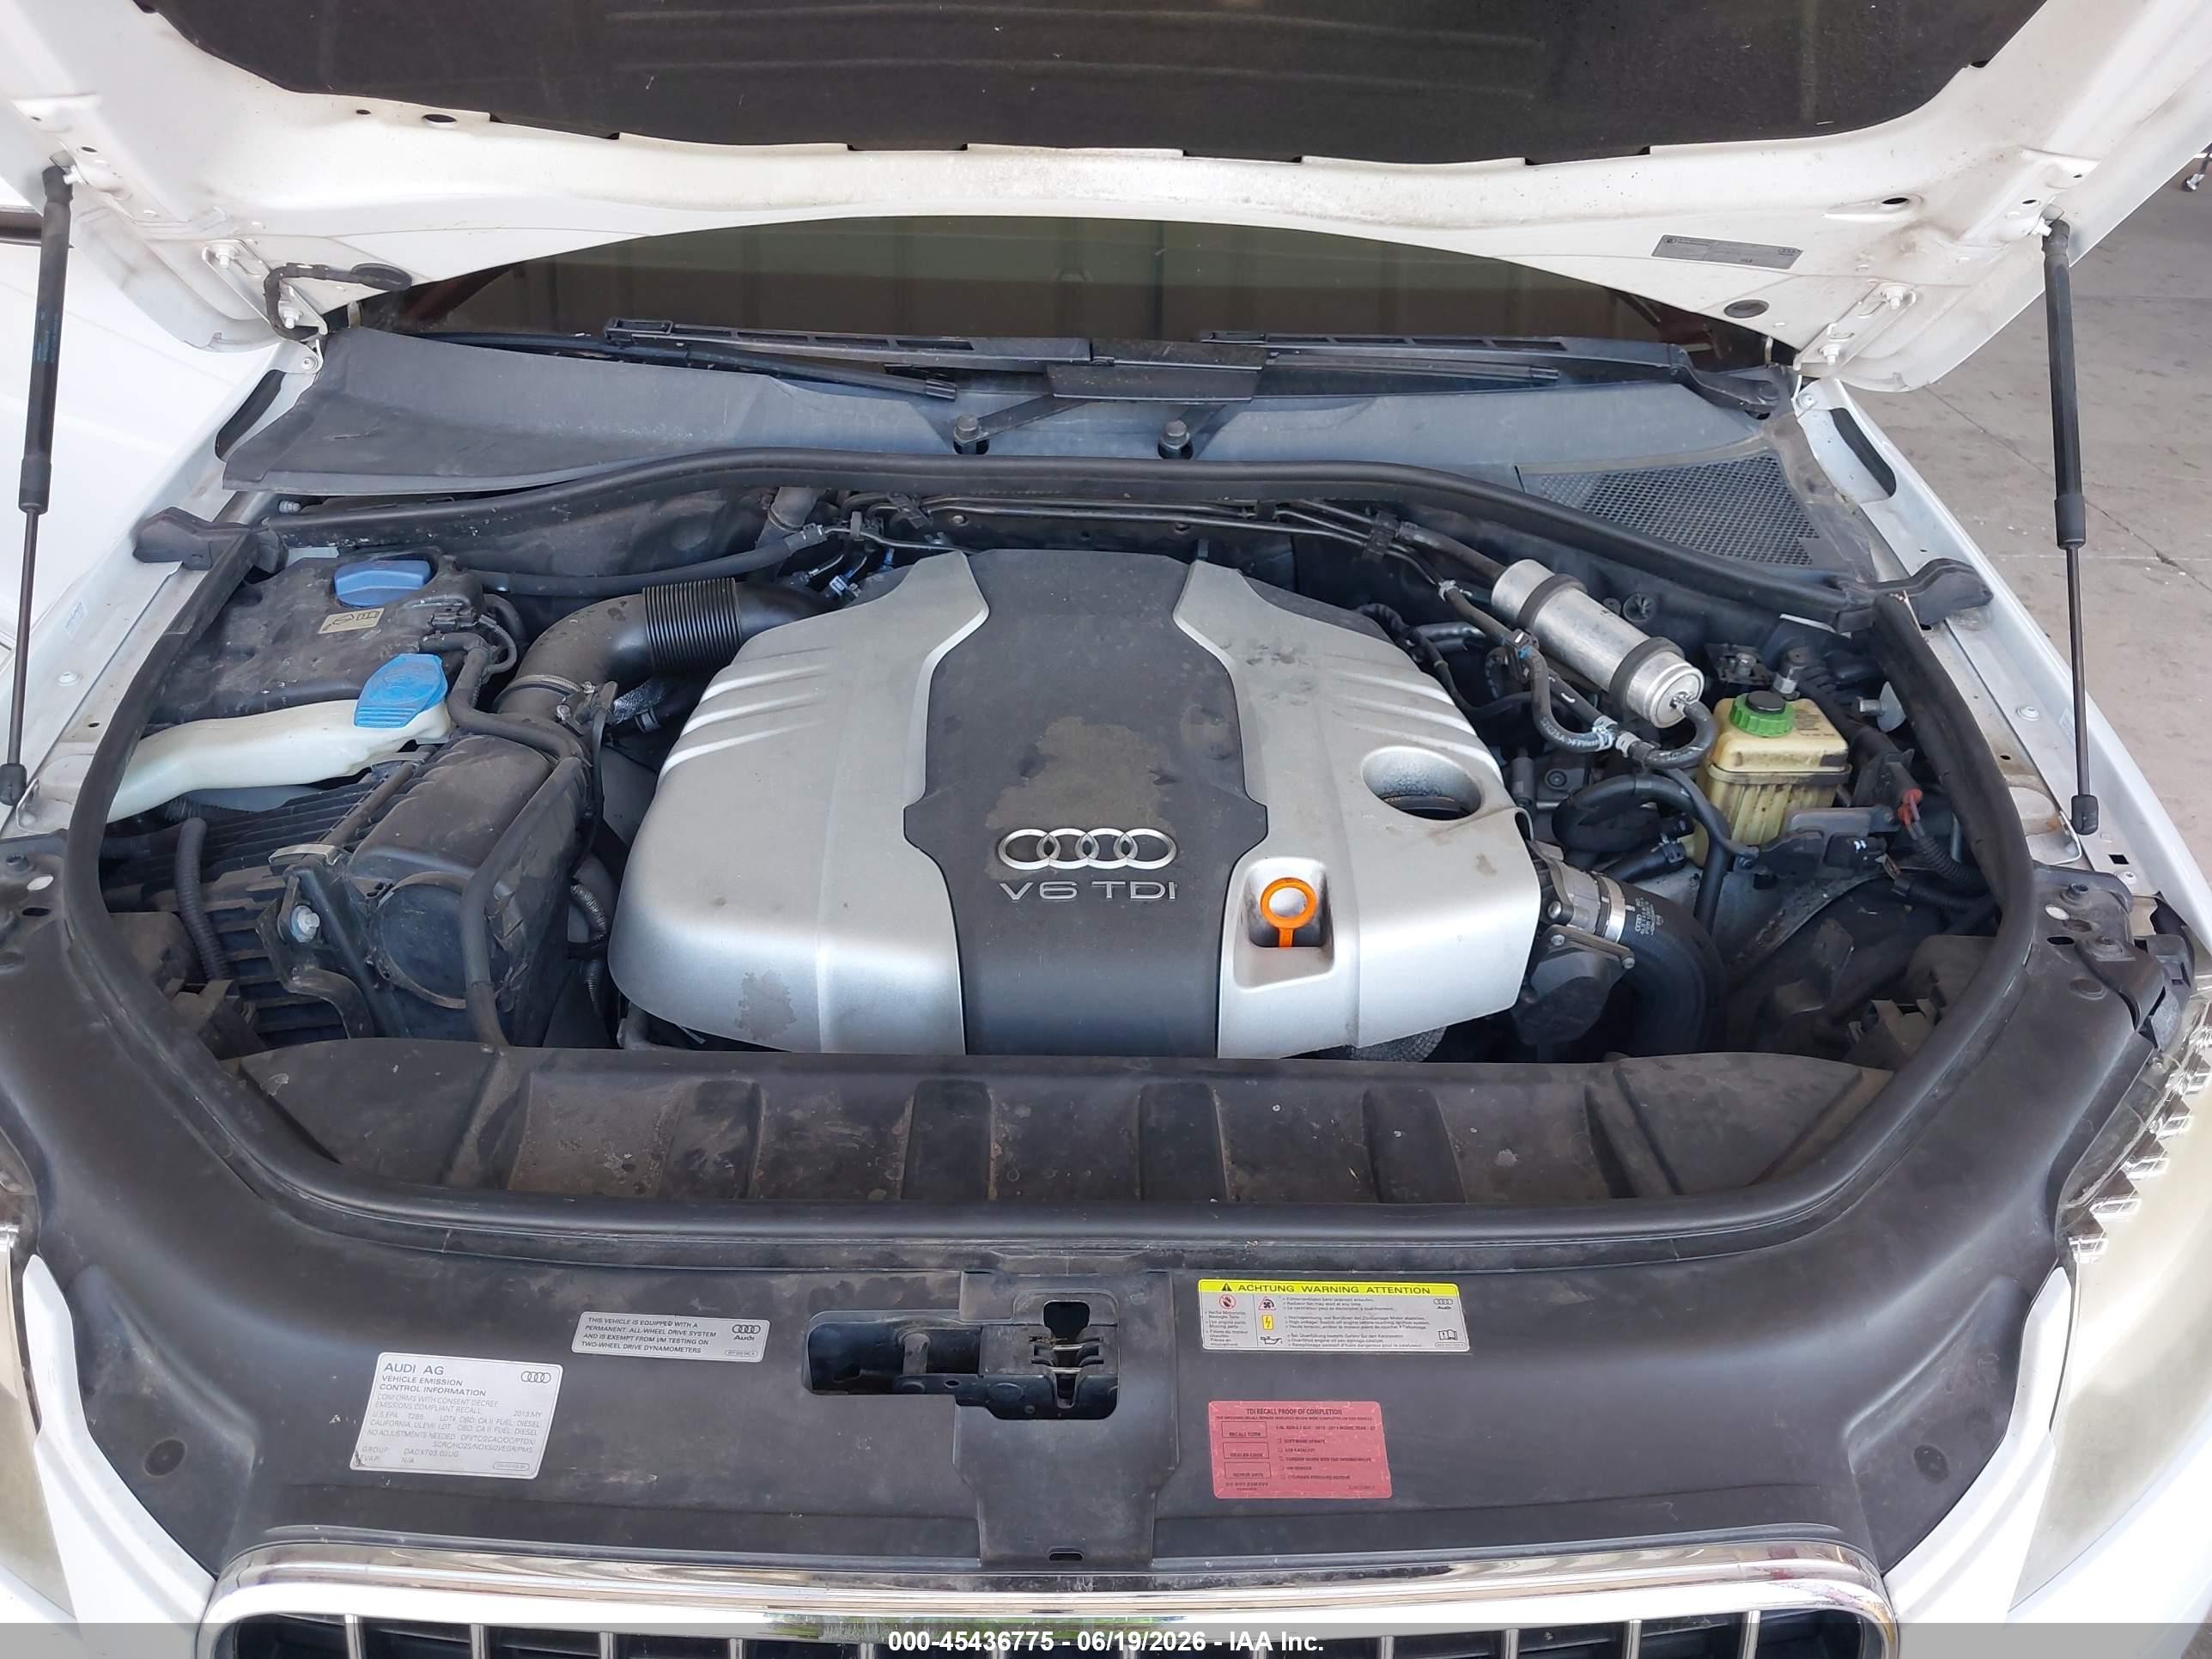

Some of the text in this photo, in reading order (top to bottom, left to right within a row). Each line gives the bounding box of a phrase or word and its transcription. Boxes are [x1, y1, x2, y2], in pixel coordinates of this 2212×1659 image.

[999, 880, 1176, 900] V6 TDI
[1301, 1285, 1359, 1293] WARNING
[1365, 1286, 1431, 1295] ATTENTION
[581, 1340, 621, 1349] TWO-WHEEL
[644, 1345, 702, 1353] DYNAMOMETERS
[384, 1363, 444, 1375] AUDI AG
[381, 1375, 463, 1386] VEHICLE EMISSION
[380, 1383, 486, 1396] CONTROL INFORMATION
[377, 1393, 499, 1408] CONFORMS WITH CONSENT DECREE
[414, 1403, 455, 1413] COMPLIANT
[516, 1419, 541, 1428] DIESEL
[379, 1429, 428, 1438] ADJUSTMENTS
[514, 1427, 538, 1436] DIESEL
